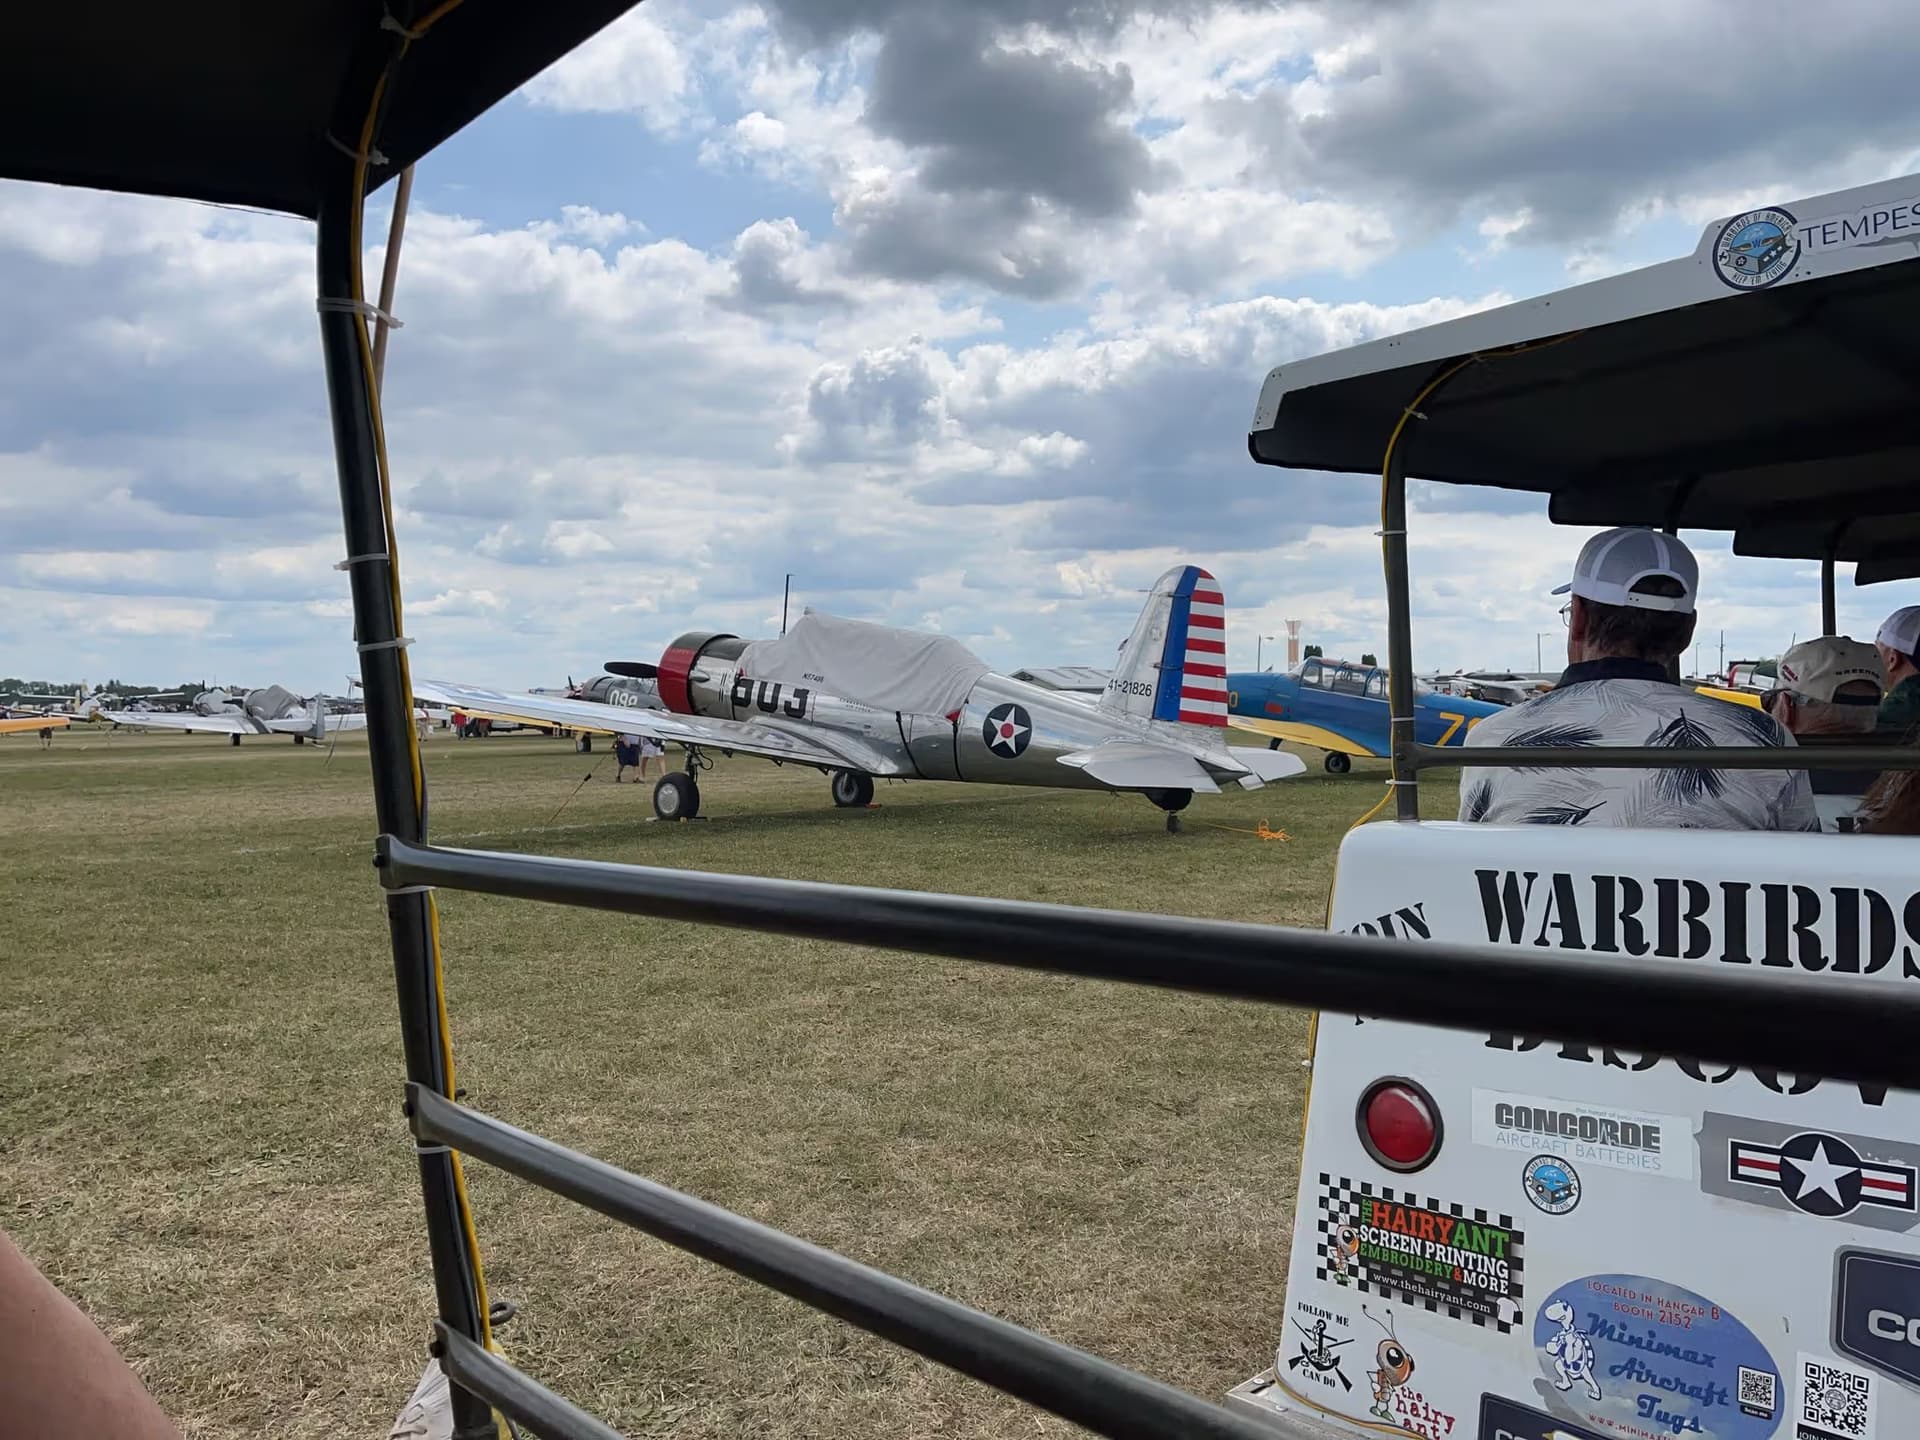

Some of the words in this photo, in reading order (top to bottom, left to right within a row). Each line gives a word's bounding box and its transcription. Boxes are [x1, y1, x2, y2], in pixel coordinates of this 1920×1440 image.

[1108, 679, 1152, 697] 41-21826
[1495, 1103, 1661, 1152] CONCORDE
[1496, 1132, 1569, 1155] AIRCRAFT
[1575, 1149, 1661, 1170] BATTERIES
[1361, 1199, 1372, 1224] THE
[1360, 1225, 1421, 1256] SCREEN
[1424, 1241, 1509, 1280] PRINTING
[1373, 1272, 1491, 1314] www.thehairyant.com
[1587, 1280, 1636, 1300] LOCATED
[1641, 1293, 1652, 1302] IN
[1657, 1297, 1705, 1318] HANGAR
[1711, 1306, 1720, 1320] B
[1298, 1302, 1332, 1320] FOLLOW
[1336, 1314, 1350, 1327] ME
[1613, 1301, 1653, 1319] BOOTH
[1659, 1310, 1691, 1330] 2152
[1587, 1312, 1716, 1369] Minimax
[1302, 1368, 1322, 1383] CAN
[1323, 1376, 1336, 1388] DO
[1401, 1386, 1423, 1402] the
[1609, 1357, 1729, 1407] Aircraft
[1395, 1394, 1456, 1435] hairy
[1402, 1418, 1441, 1440] ant
[1637, 1394, 1703, 1435] Tugs
